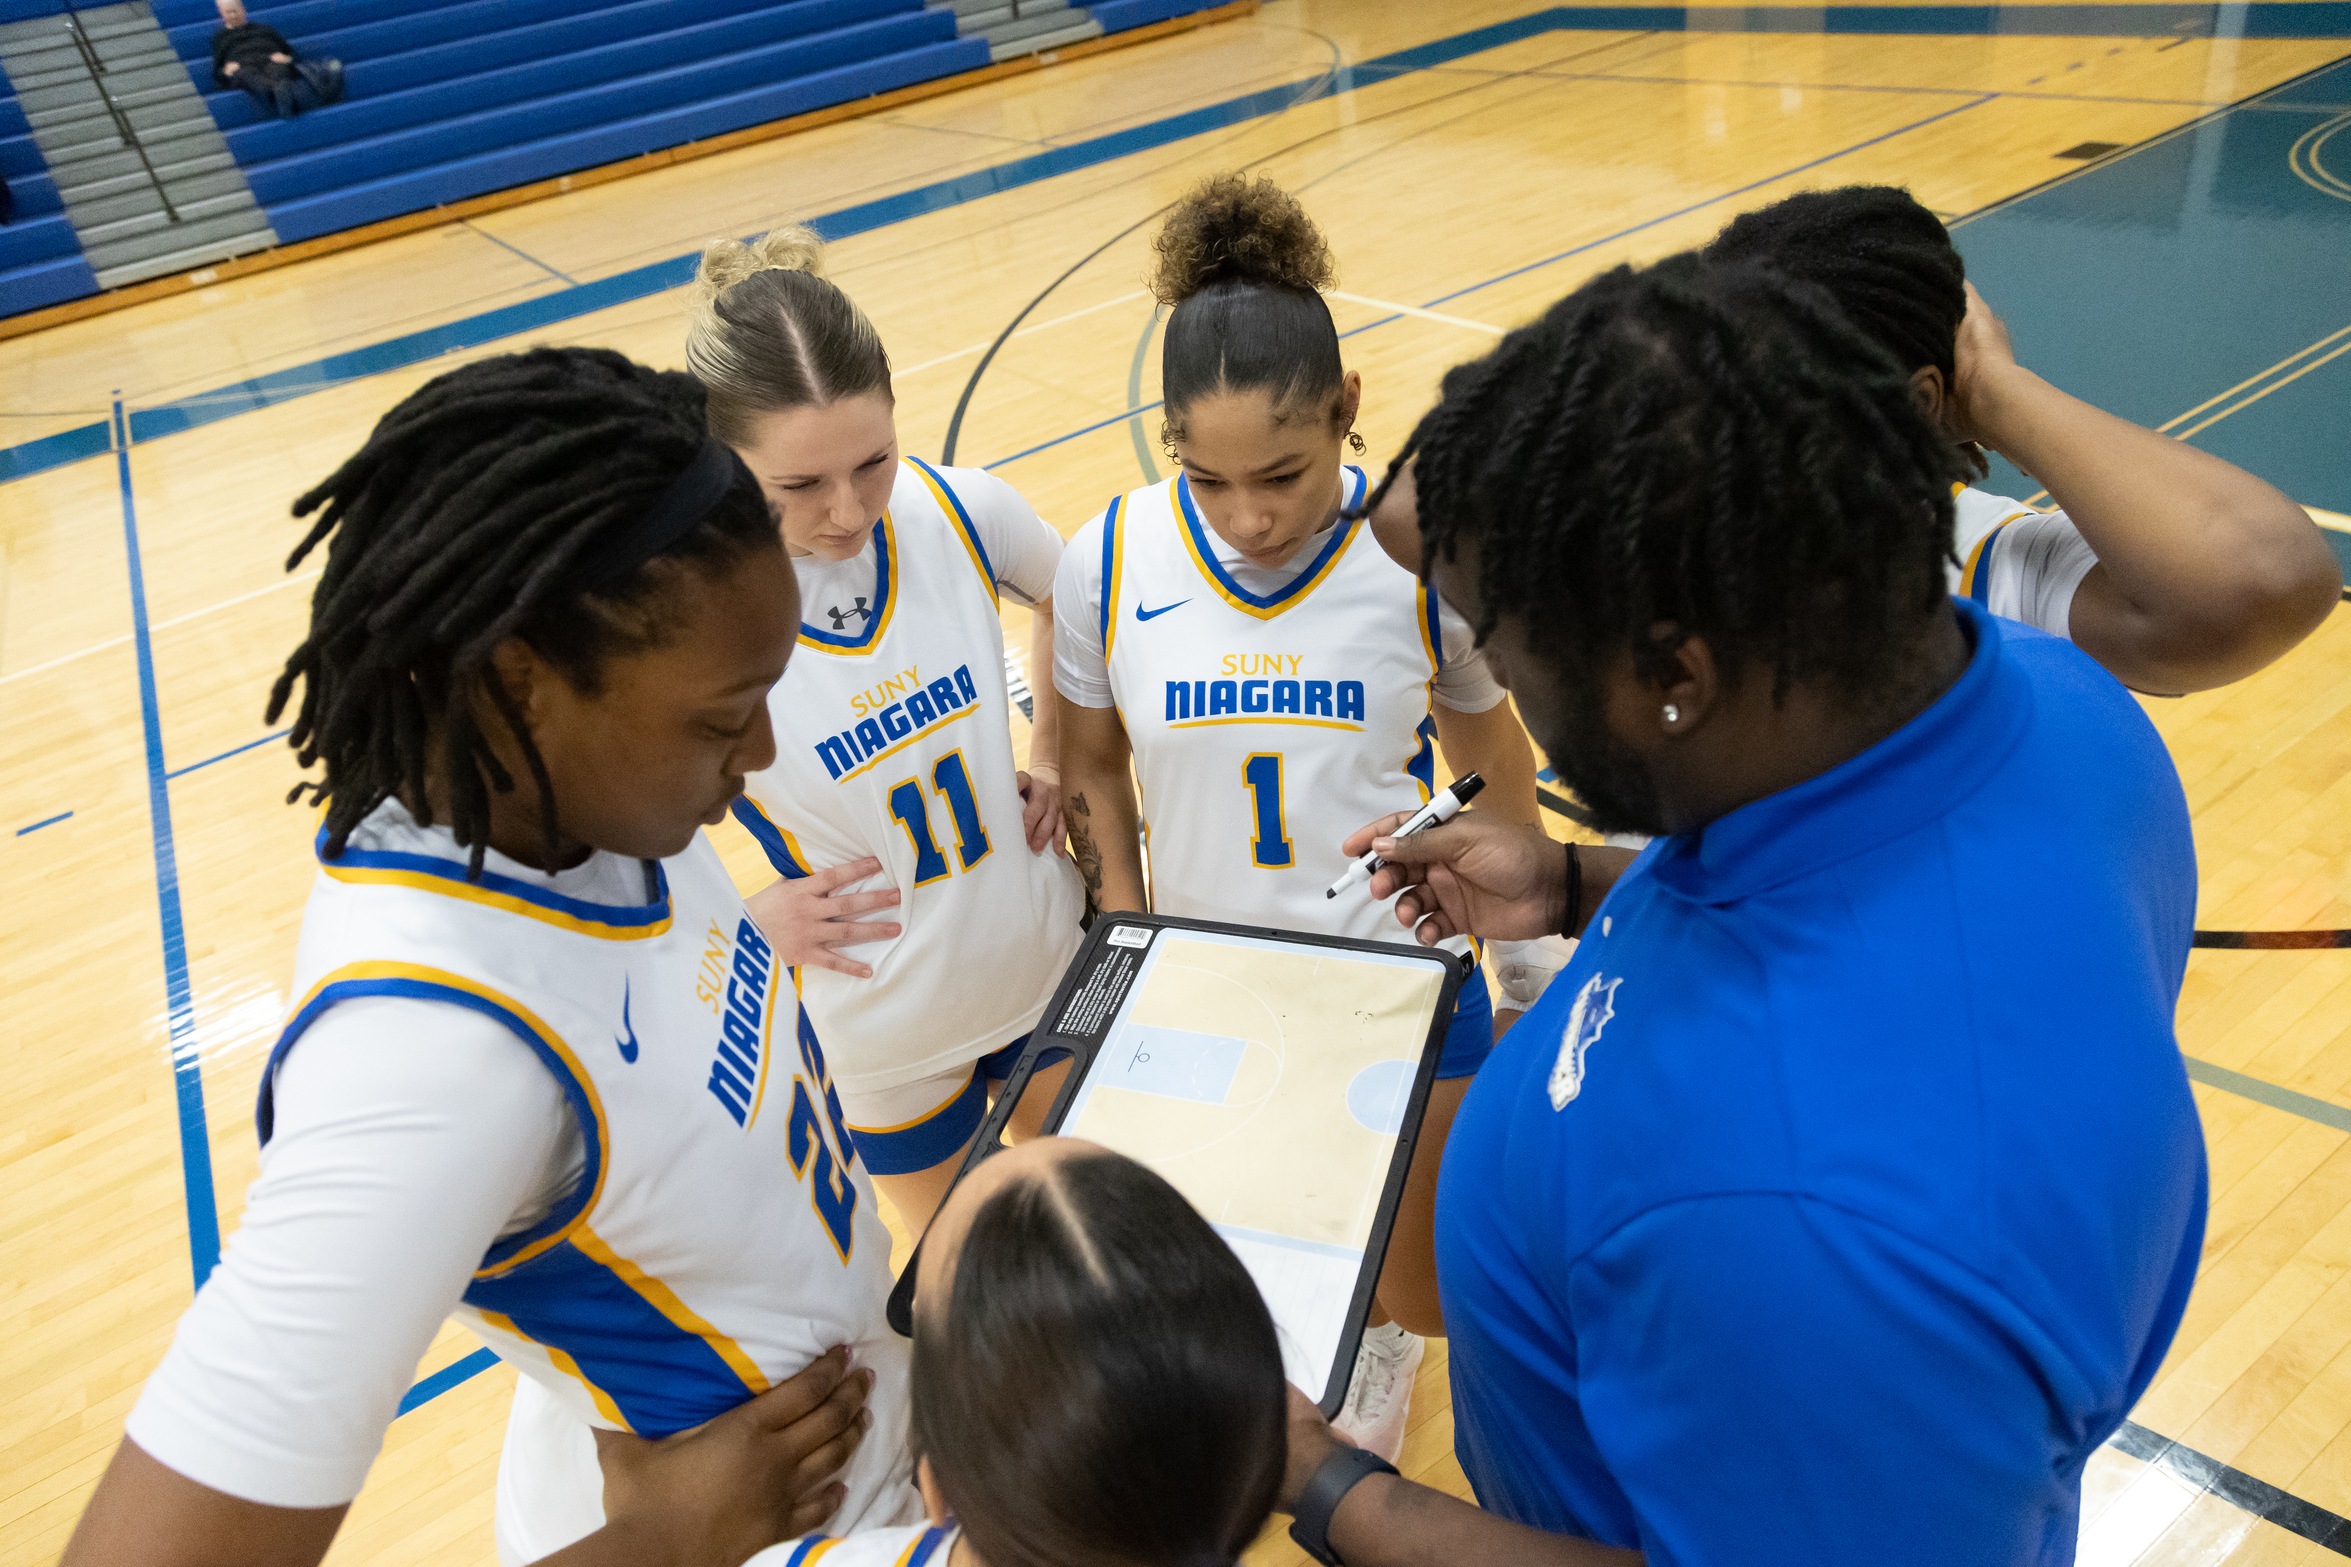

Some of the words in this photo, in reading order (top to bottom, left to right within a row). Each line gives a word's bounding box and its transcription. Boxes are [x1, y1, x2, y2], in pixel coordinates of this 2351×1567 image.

[849, 664, 921, 719] SUNY
[1165, 679, 1365, 722] NIAGARA
[1221, 653, 1304, 677] SUNY
[814, 663, 978, 781] NIAGARA
[887, 747, 994, 889] 11
[1241, 752, 1296, 870] 1
[696, 917, 732, 1015] SUNY
[706, 908, 772, 1128] NIAGAR
